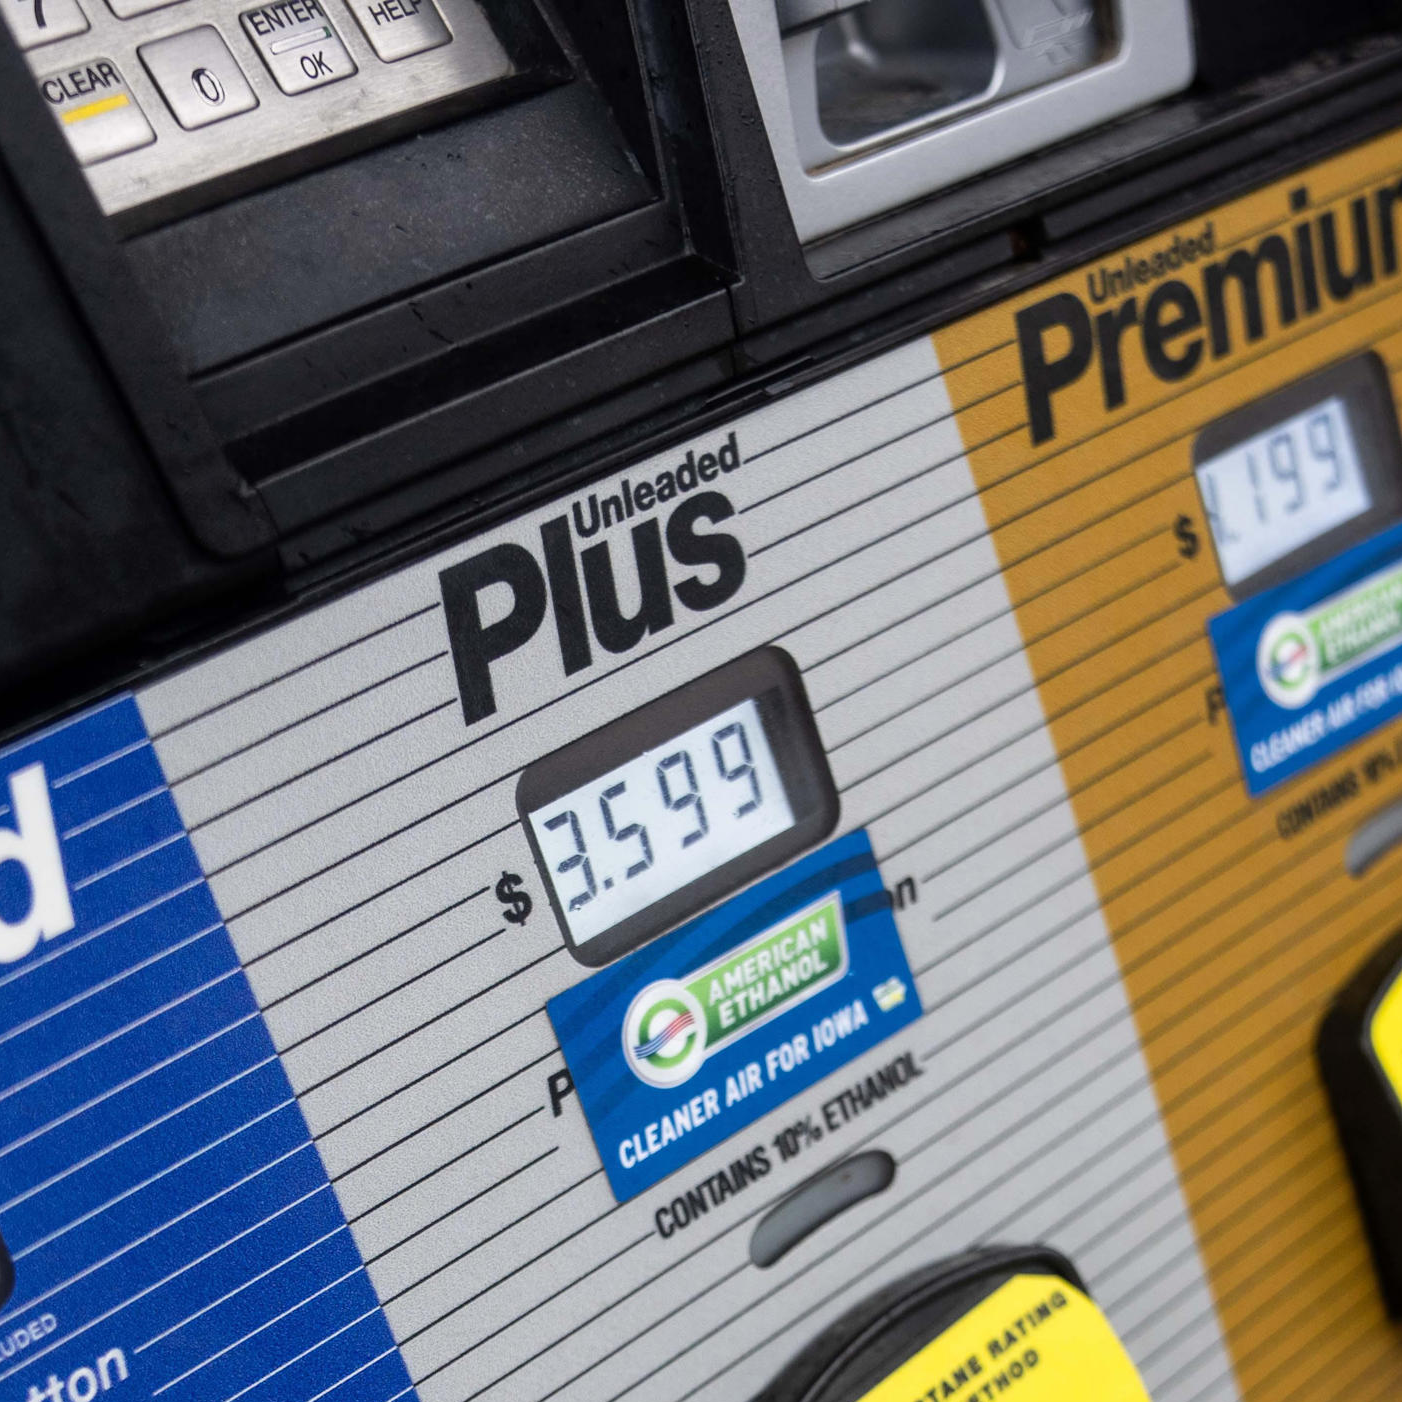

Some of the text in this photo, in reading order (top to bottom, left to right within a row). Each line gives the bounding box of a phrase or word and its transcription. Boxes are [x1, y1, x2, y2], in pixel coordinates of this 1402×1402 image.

[247, 0, 324, 36] ENTER
[41, 62, 121, 105] CLEAR
[191, 67, 225, 106] 0
[300, 51, 333, 80] OK
[1088, 222, 1215, 304] Unleaded
[571, 431, 741, 539] Unleaded
[1174, 514, 1201, 559] $
[438, 490, 747, 727] Plus
[495, 721, 763, 925] $ 3.599
[709, 917, 828, 1007] AMERICAN
[718, 950, 828, 1029] ETHANOL
[619, 1088, 720, 1168] CLEANER
[725, 1062, 763, 1107] AIR
[765, 1034, 810, 1081] FOR
[812, 999, 869, 1053] IOWA
[655, 1051, 925, 1239] CONTAINS 10% ETHANOL
[987, 1291, 1068, 1359] RATING
